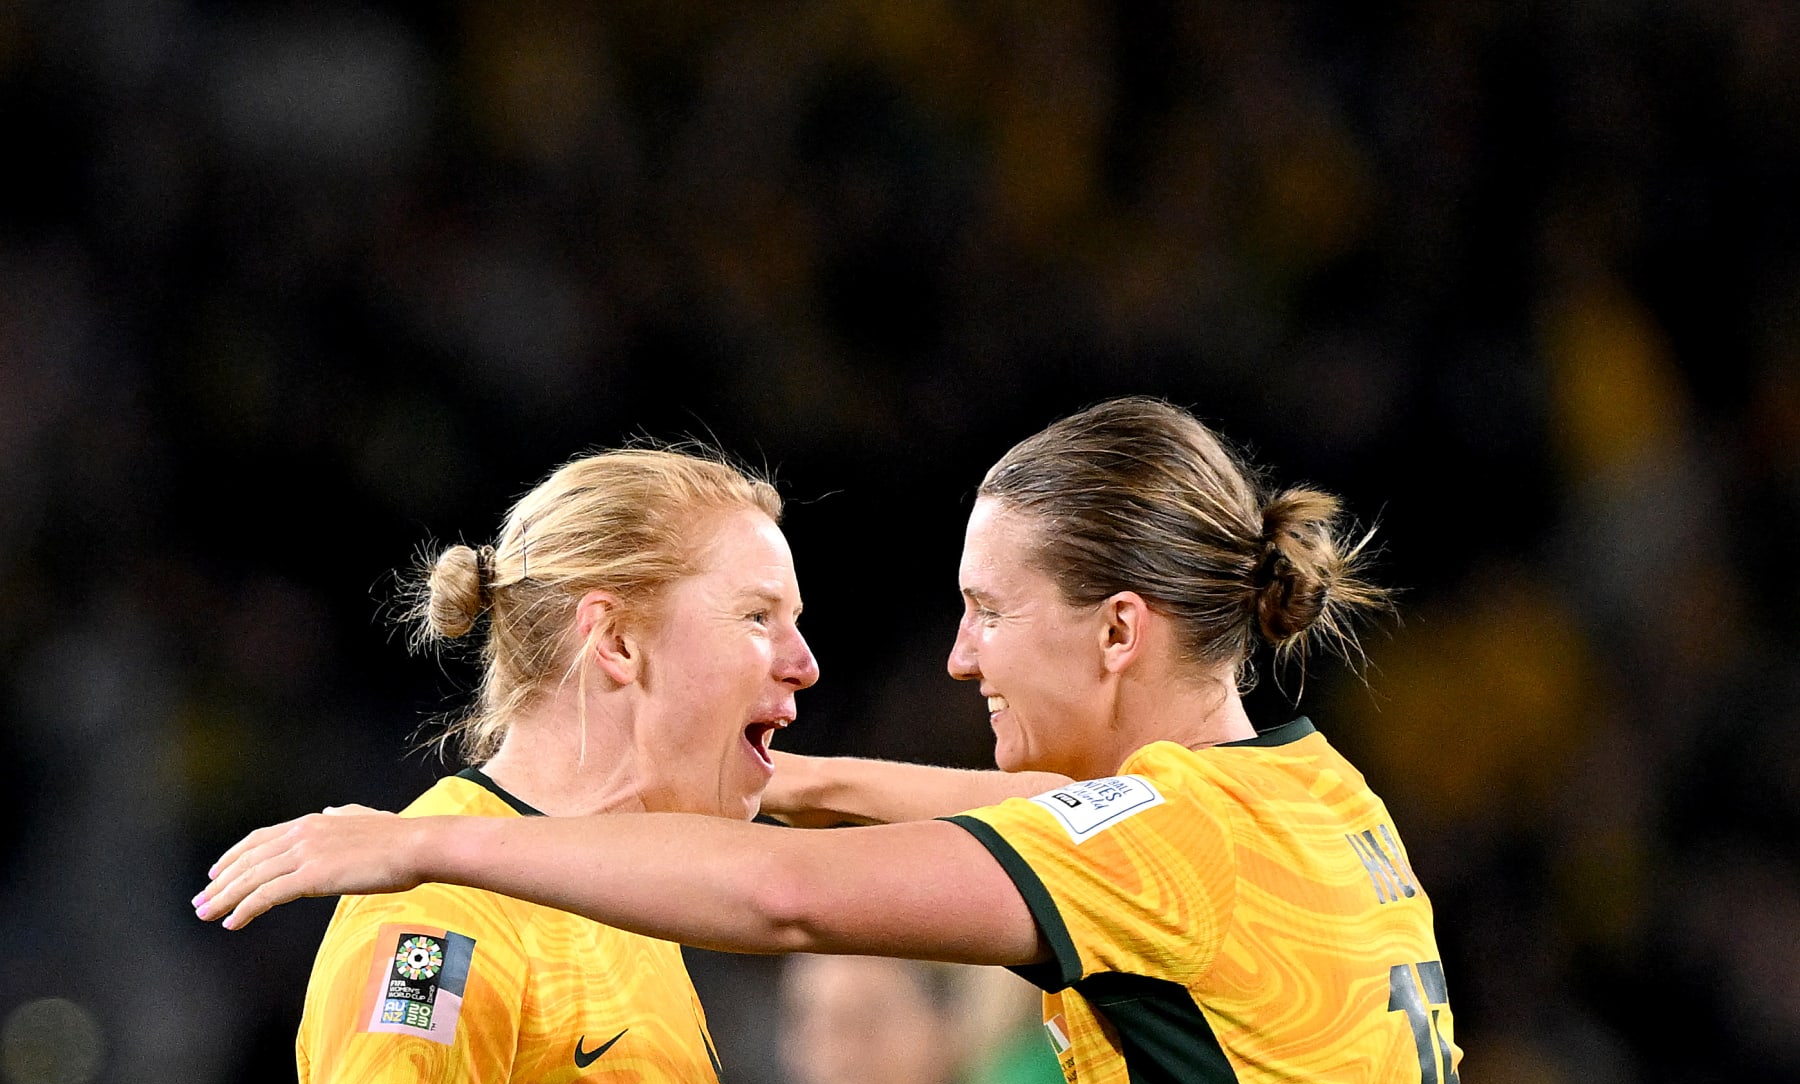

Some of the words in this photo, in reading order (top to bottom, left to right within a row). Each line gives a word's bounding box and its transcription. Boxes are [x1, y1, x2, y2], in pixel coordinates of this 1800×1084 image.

[1081, 781, 1123, 802] NITES
[1345, 823, 1416, 904] HU
[390, 986, 420, 995] WOMEN'S
[385, 1001, 406, 1012] AU
[382, 1011, 404, 1022] NZ
